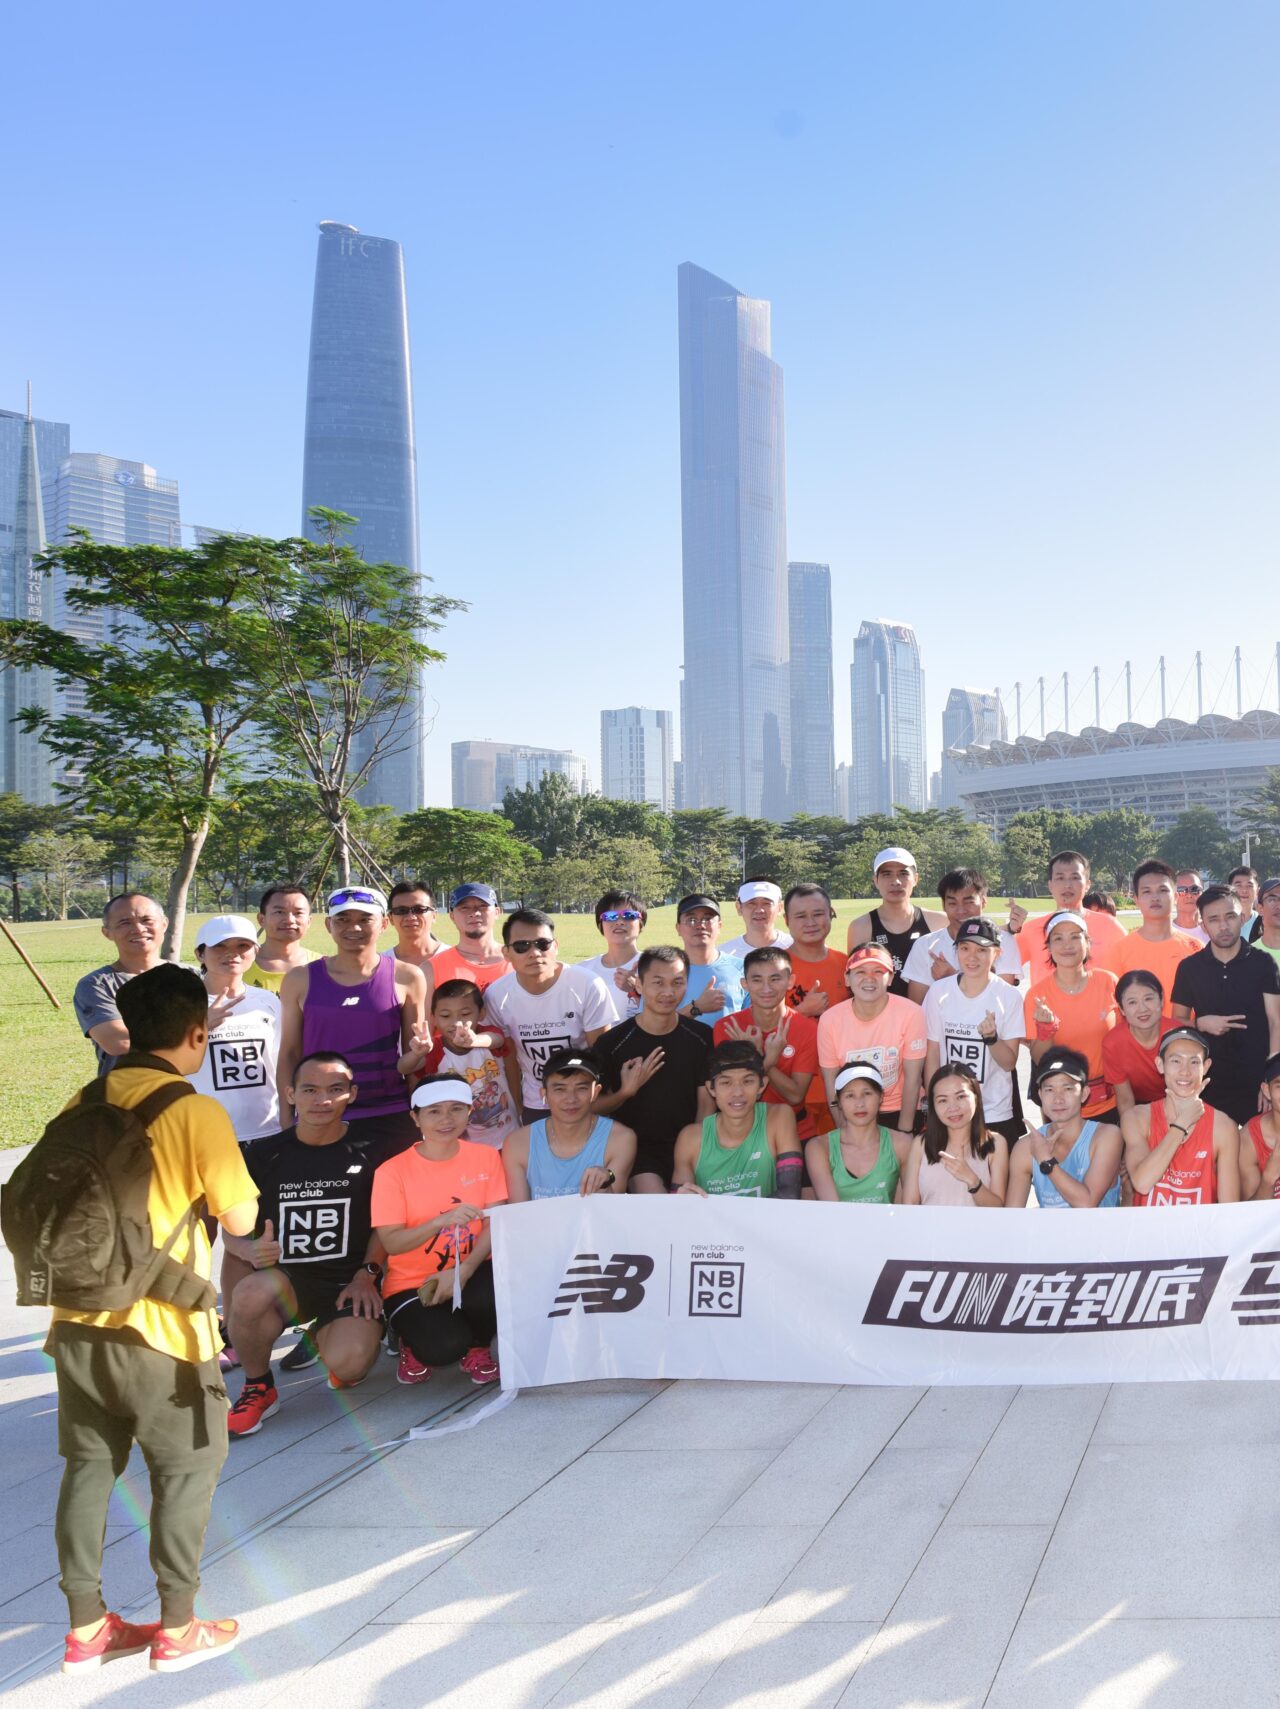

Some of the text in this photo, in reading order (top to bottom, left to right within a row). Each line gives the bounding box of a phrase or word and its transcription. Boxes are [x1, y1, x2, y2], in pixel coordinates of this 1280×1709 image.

[225, 1030, 245, 1038] club
[219, 1046, 259, 1064] NB
[950, 1043, 980, 1060] NB
[222, 1064, 259, 1083] RC
[279, 1188, 324, 1199] run club
[280, 1179, 350, 1190] new balance
[289, 1208, 339, 1231] NB
[288, 1231, 337, 1255] RC
[710, 1244, 745, 1252] balance
[547, 1253, 655, 1319] NB
[698, 1270, 735, 1288] NB
[697, 1290, 734, 1310] RC
[886, 1270, 1007, 1325] FUN
[1000, 1263, 1205, 1327] 陪到底
